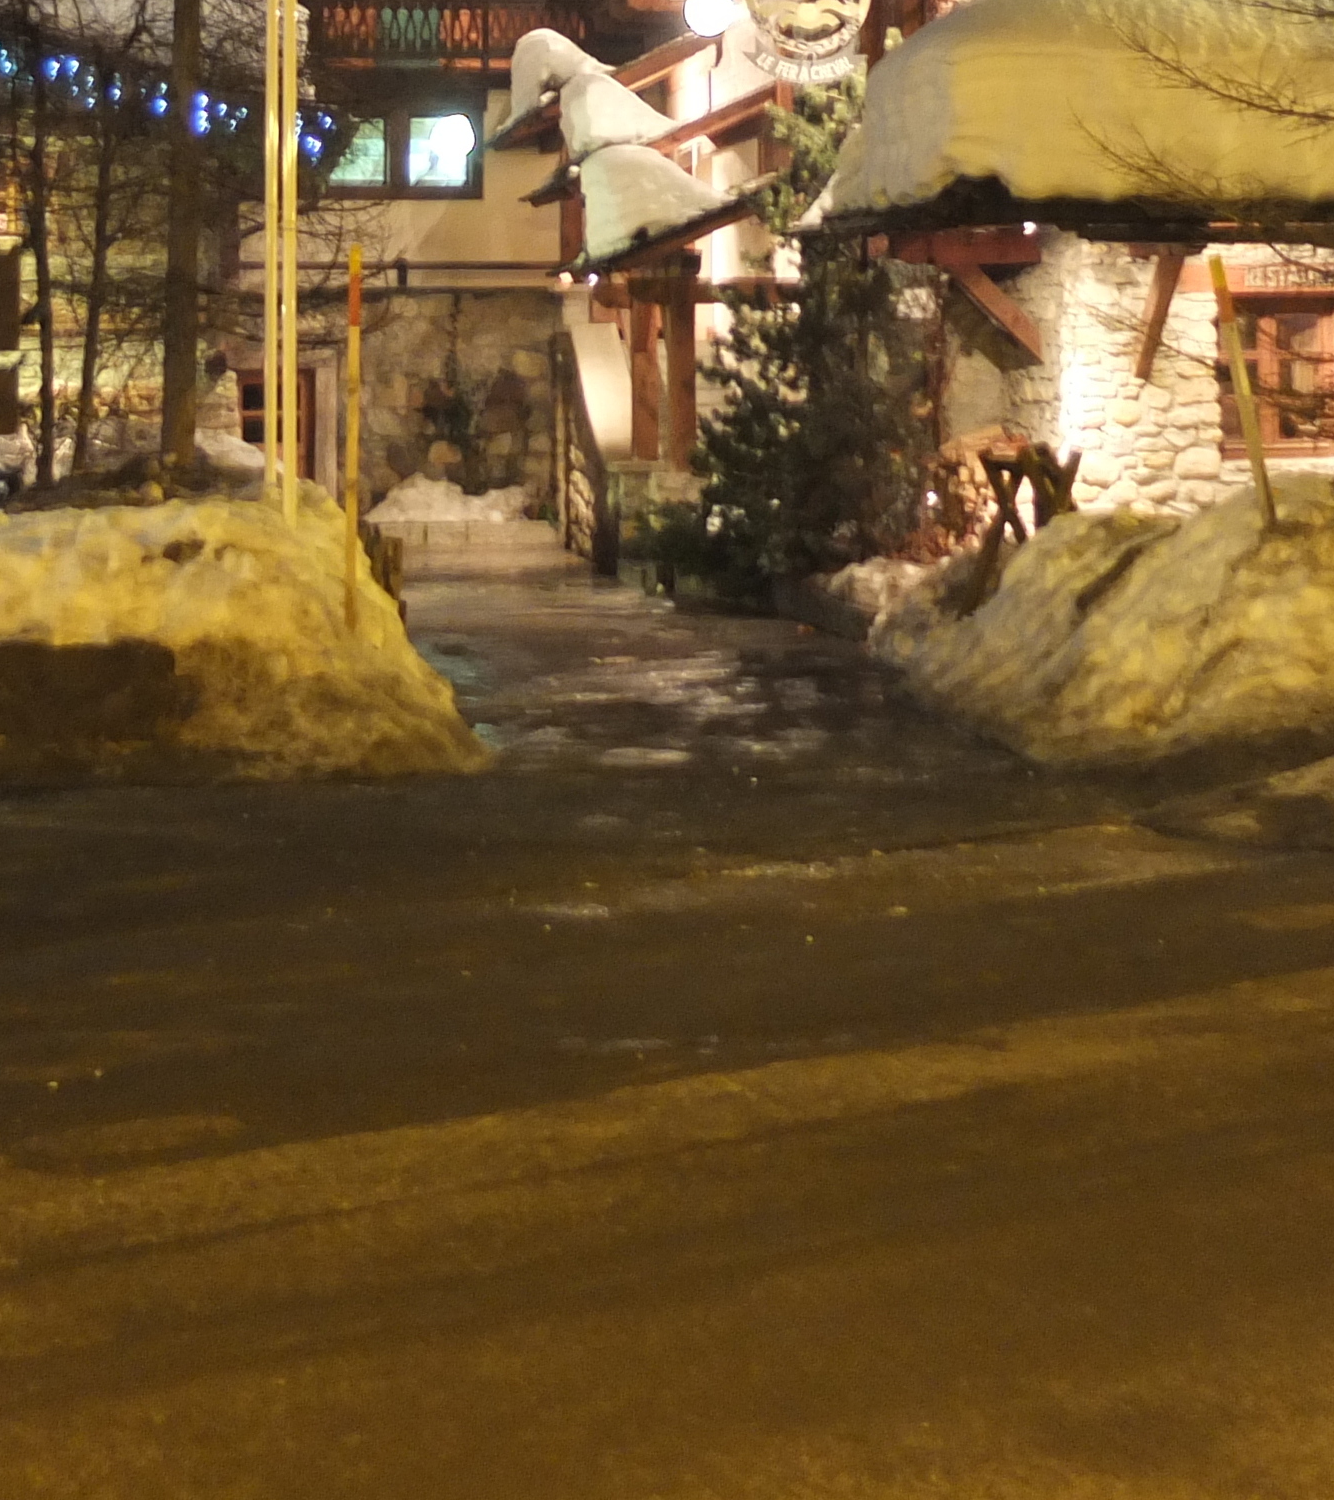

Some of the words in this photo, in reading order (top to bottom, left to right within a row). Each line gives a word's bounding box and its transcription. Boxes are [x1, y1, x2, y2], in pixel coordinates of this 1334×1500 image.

[756, 53, 775, 70] LE
[775, 61, 799, 79] FER
[810, 57, 855, 79] CHEVAL
